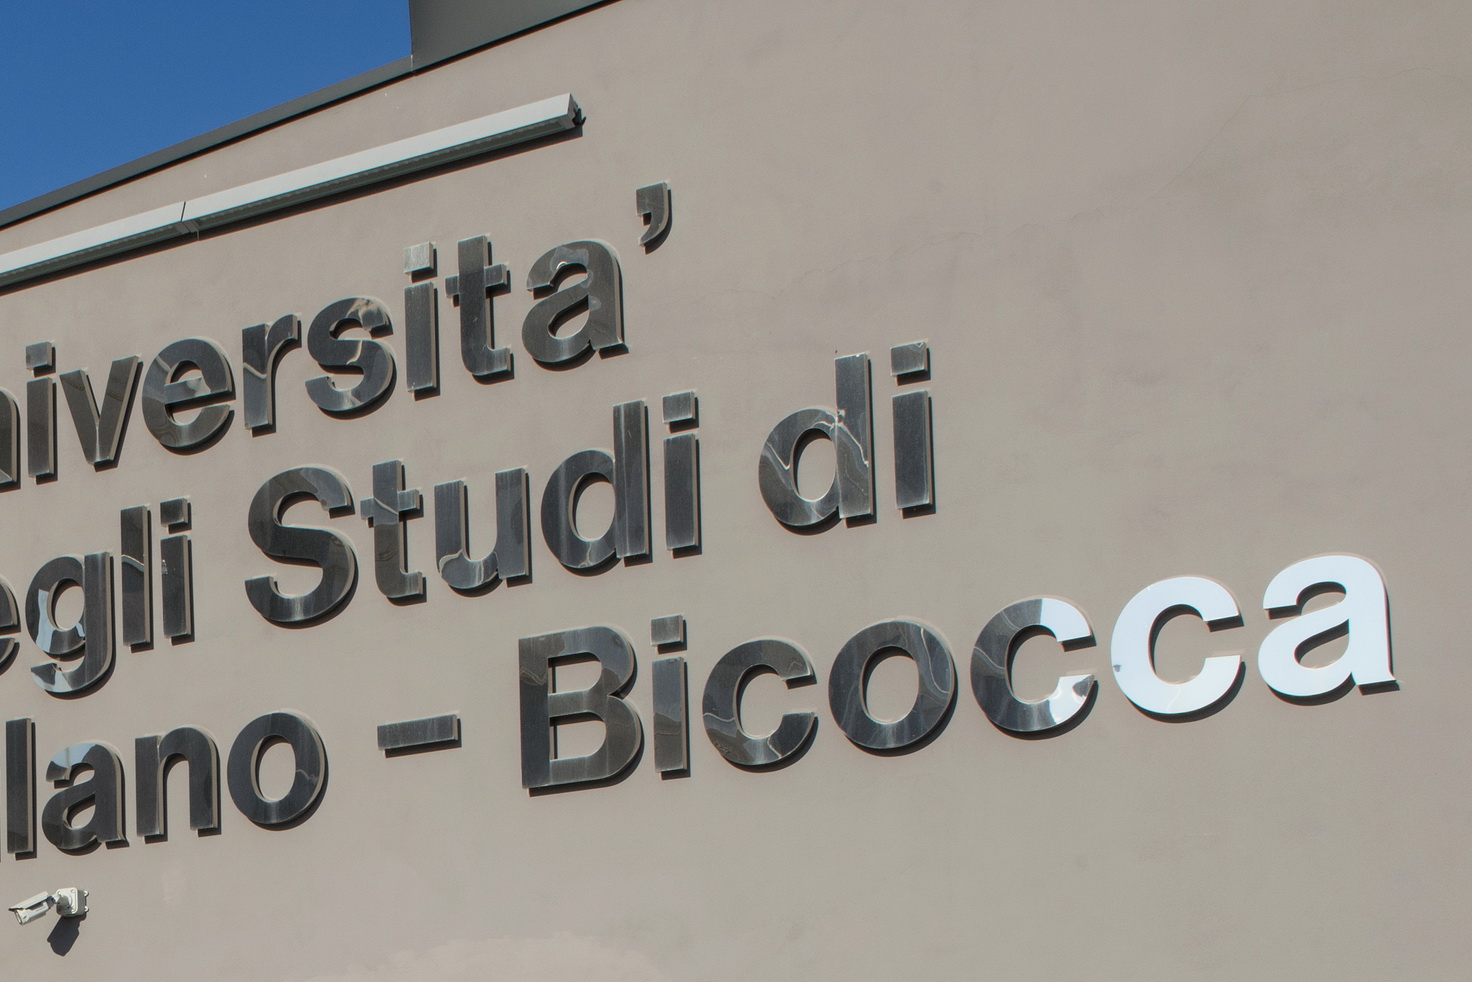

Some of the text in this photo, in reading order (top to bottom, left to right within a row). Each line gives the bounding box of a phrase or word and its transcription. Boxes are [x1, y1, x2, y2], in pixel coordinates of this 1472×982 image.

[245, 391, 699, 622] Studi
[759, 341, 933, 528] di
[519, 554, 1396, 789] Bicocca
